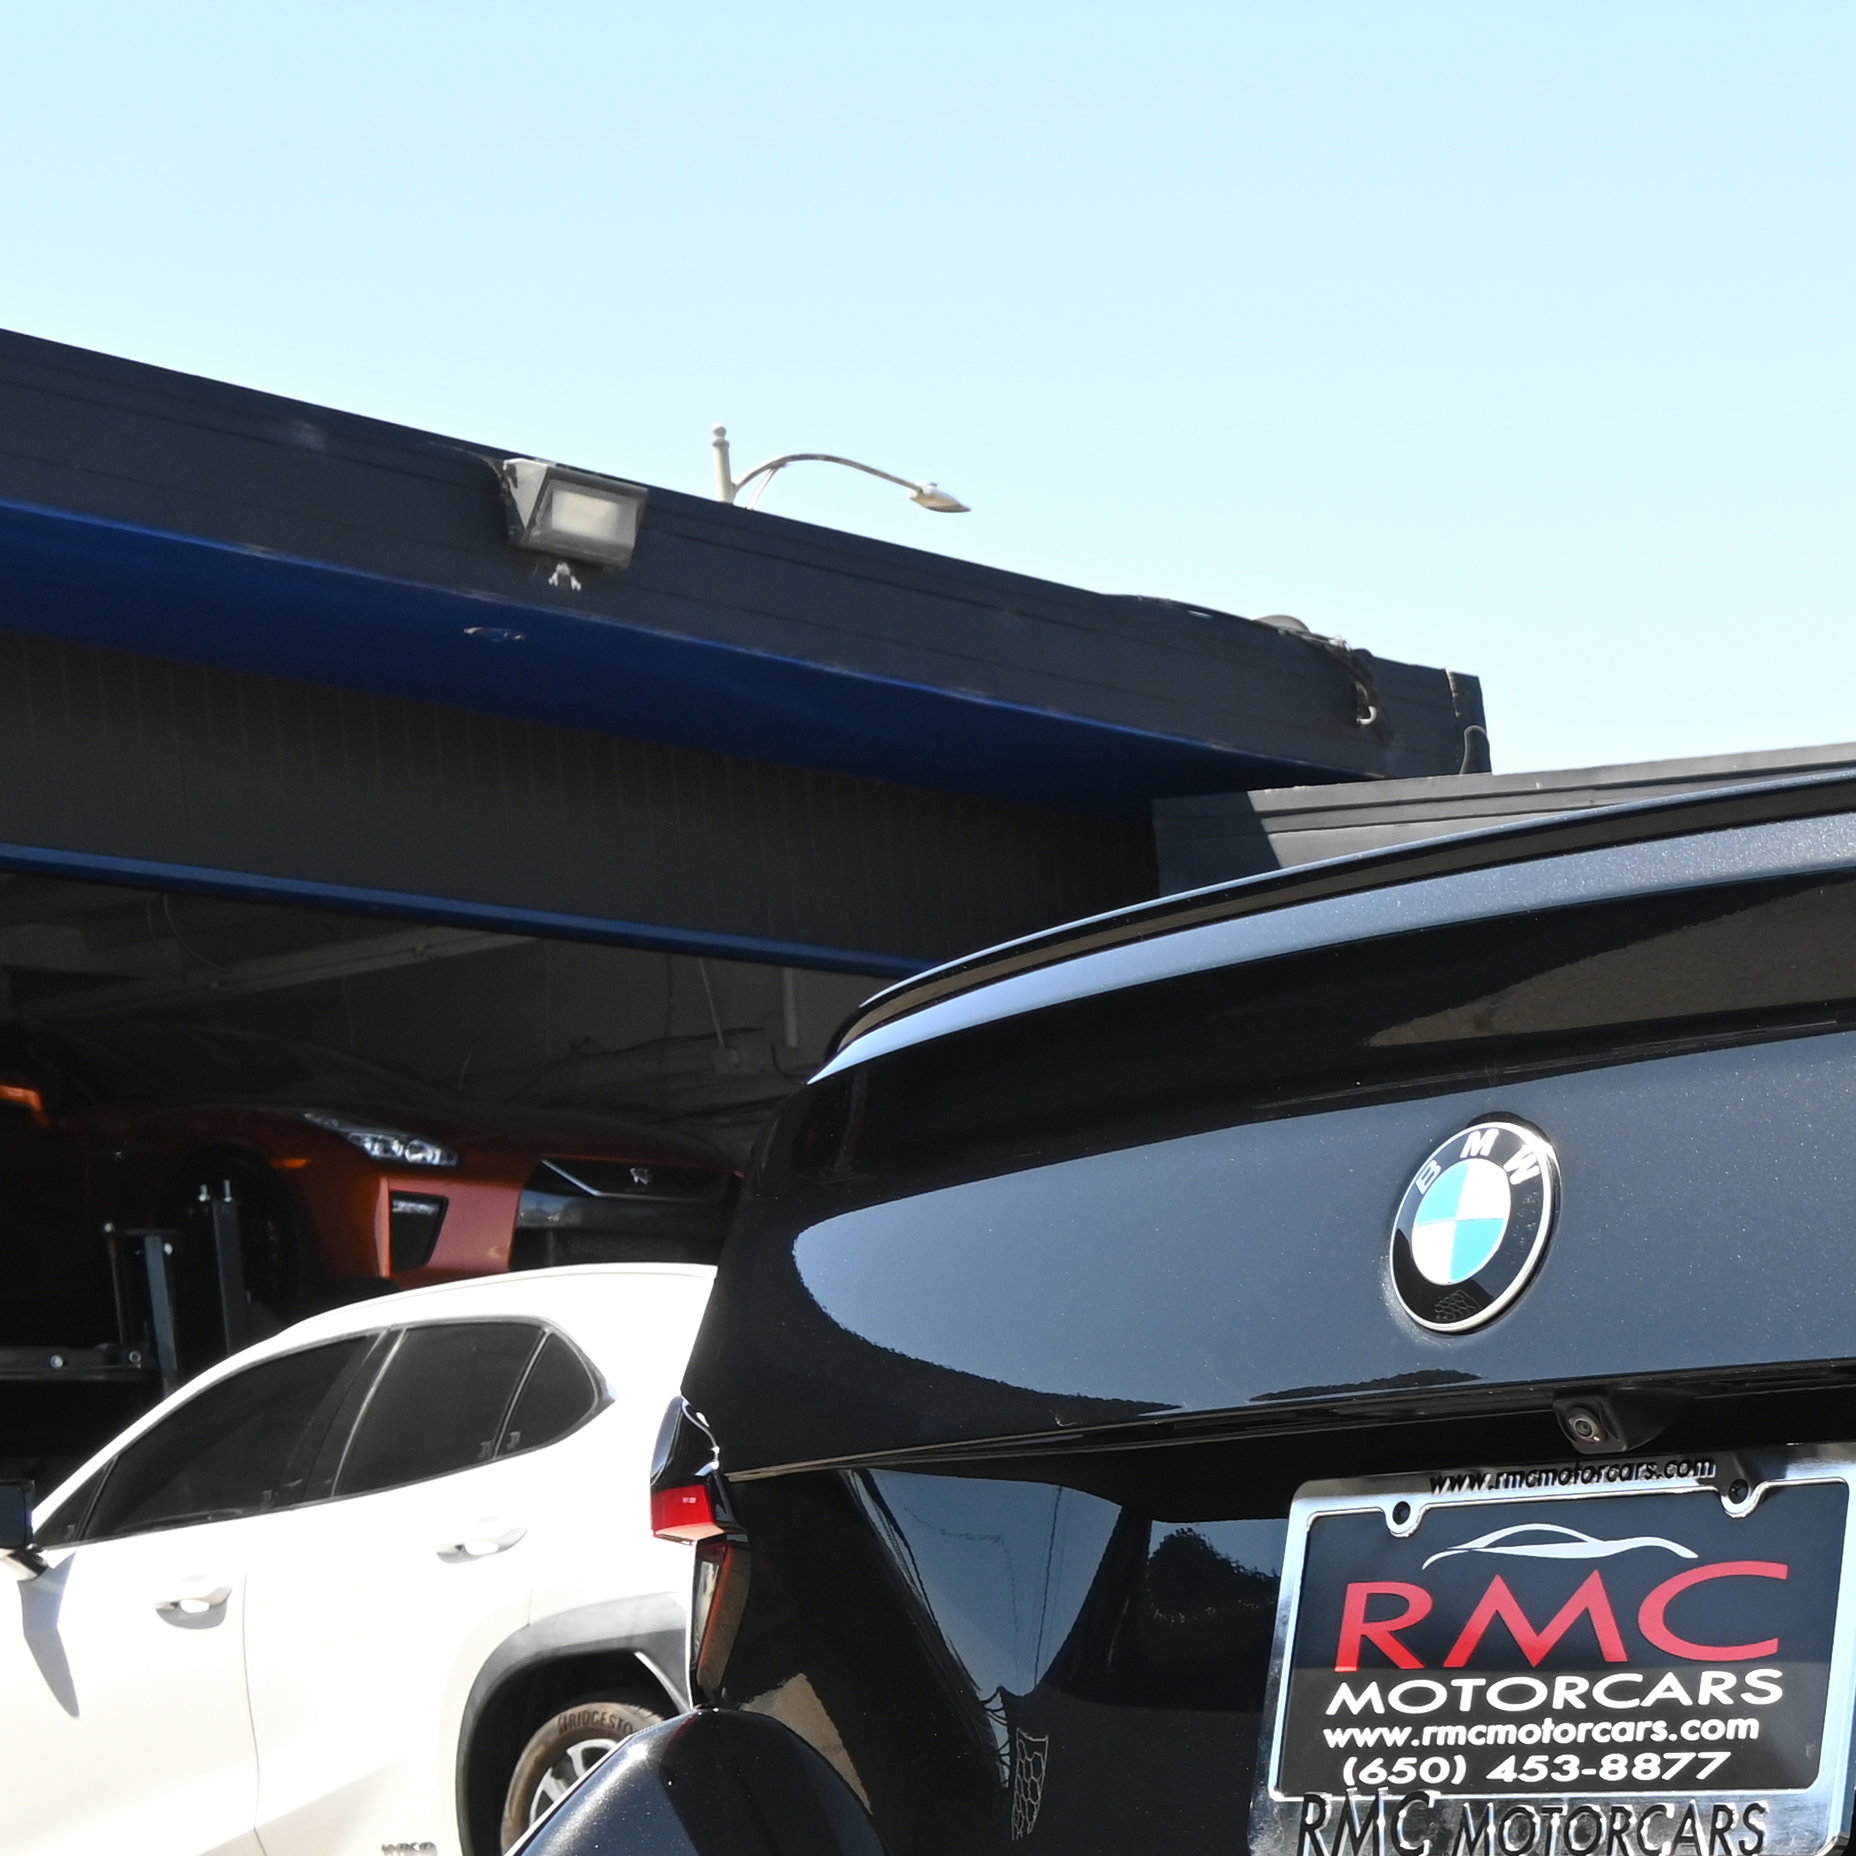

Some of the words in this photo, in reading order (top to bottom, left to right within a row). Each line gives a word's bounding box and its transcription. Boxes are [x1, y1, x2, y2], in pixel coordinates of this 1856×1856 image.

[1415, 1126, 1541, 1196] BMW
[1429, 1457, 1717, 1496] www.rmcmotorcars.com
[1335, 1560, 1789, 1672] RMC
[1325, 1668, 1784, 1716] MOTORCARS
[557, 1709, 636, 1735] BRIDGESTO
[1323, 1713, 1759, 1750] www.rmcmotorcars.com
[1342, 1754, 1467, 1787] (650)
[1486, 1751, 1732, 1783] 453-8877
